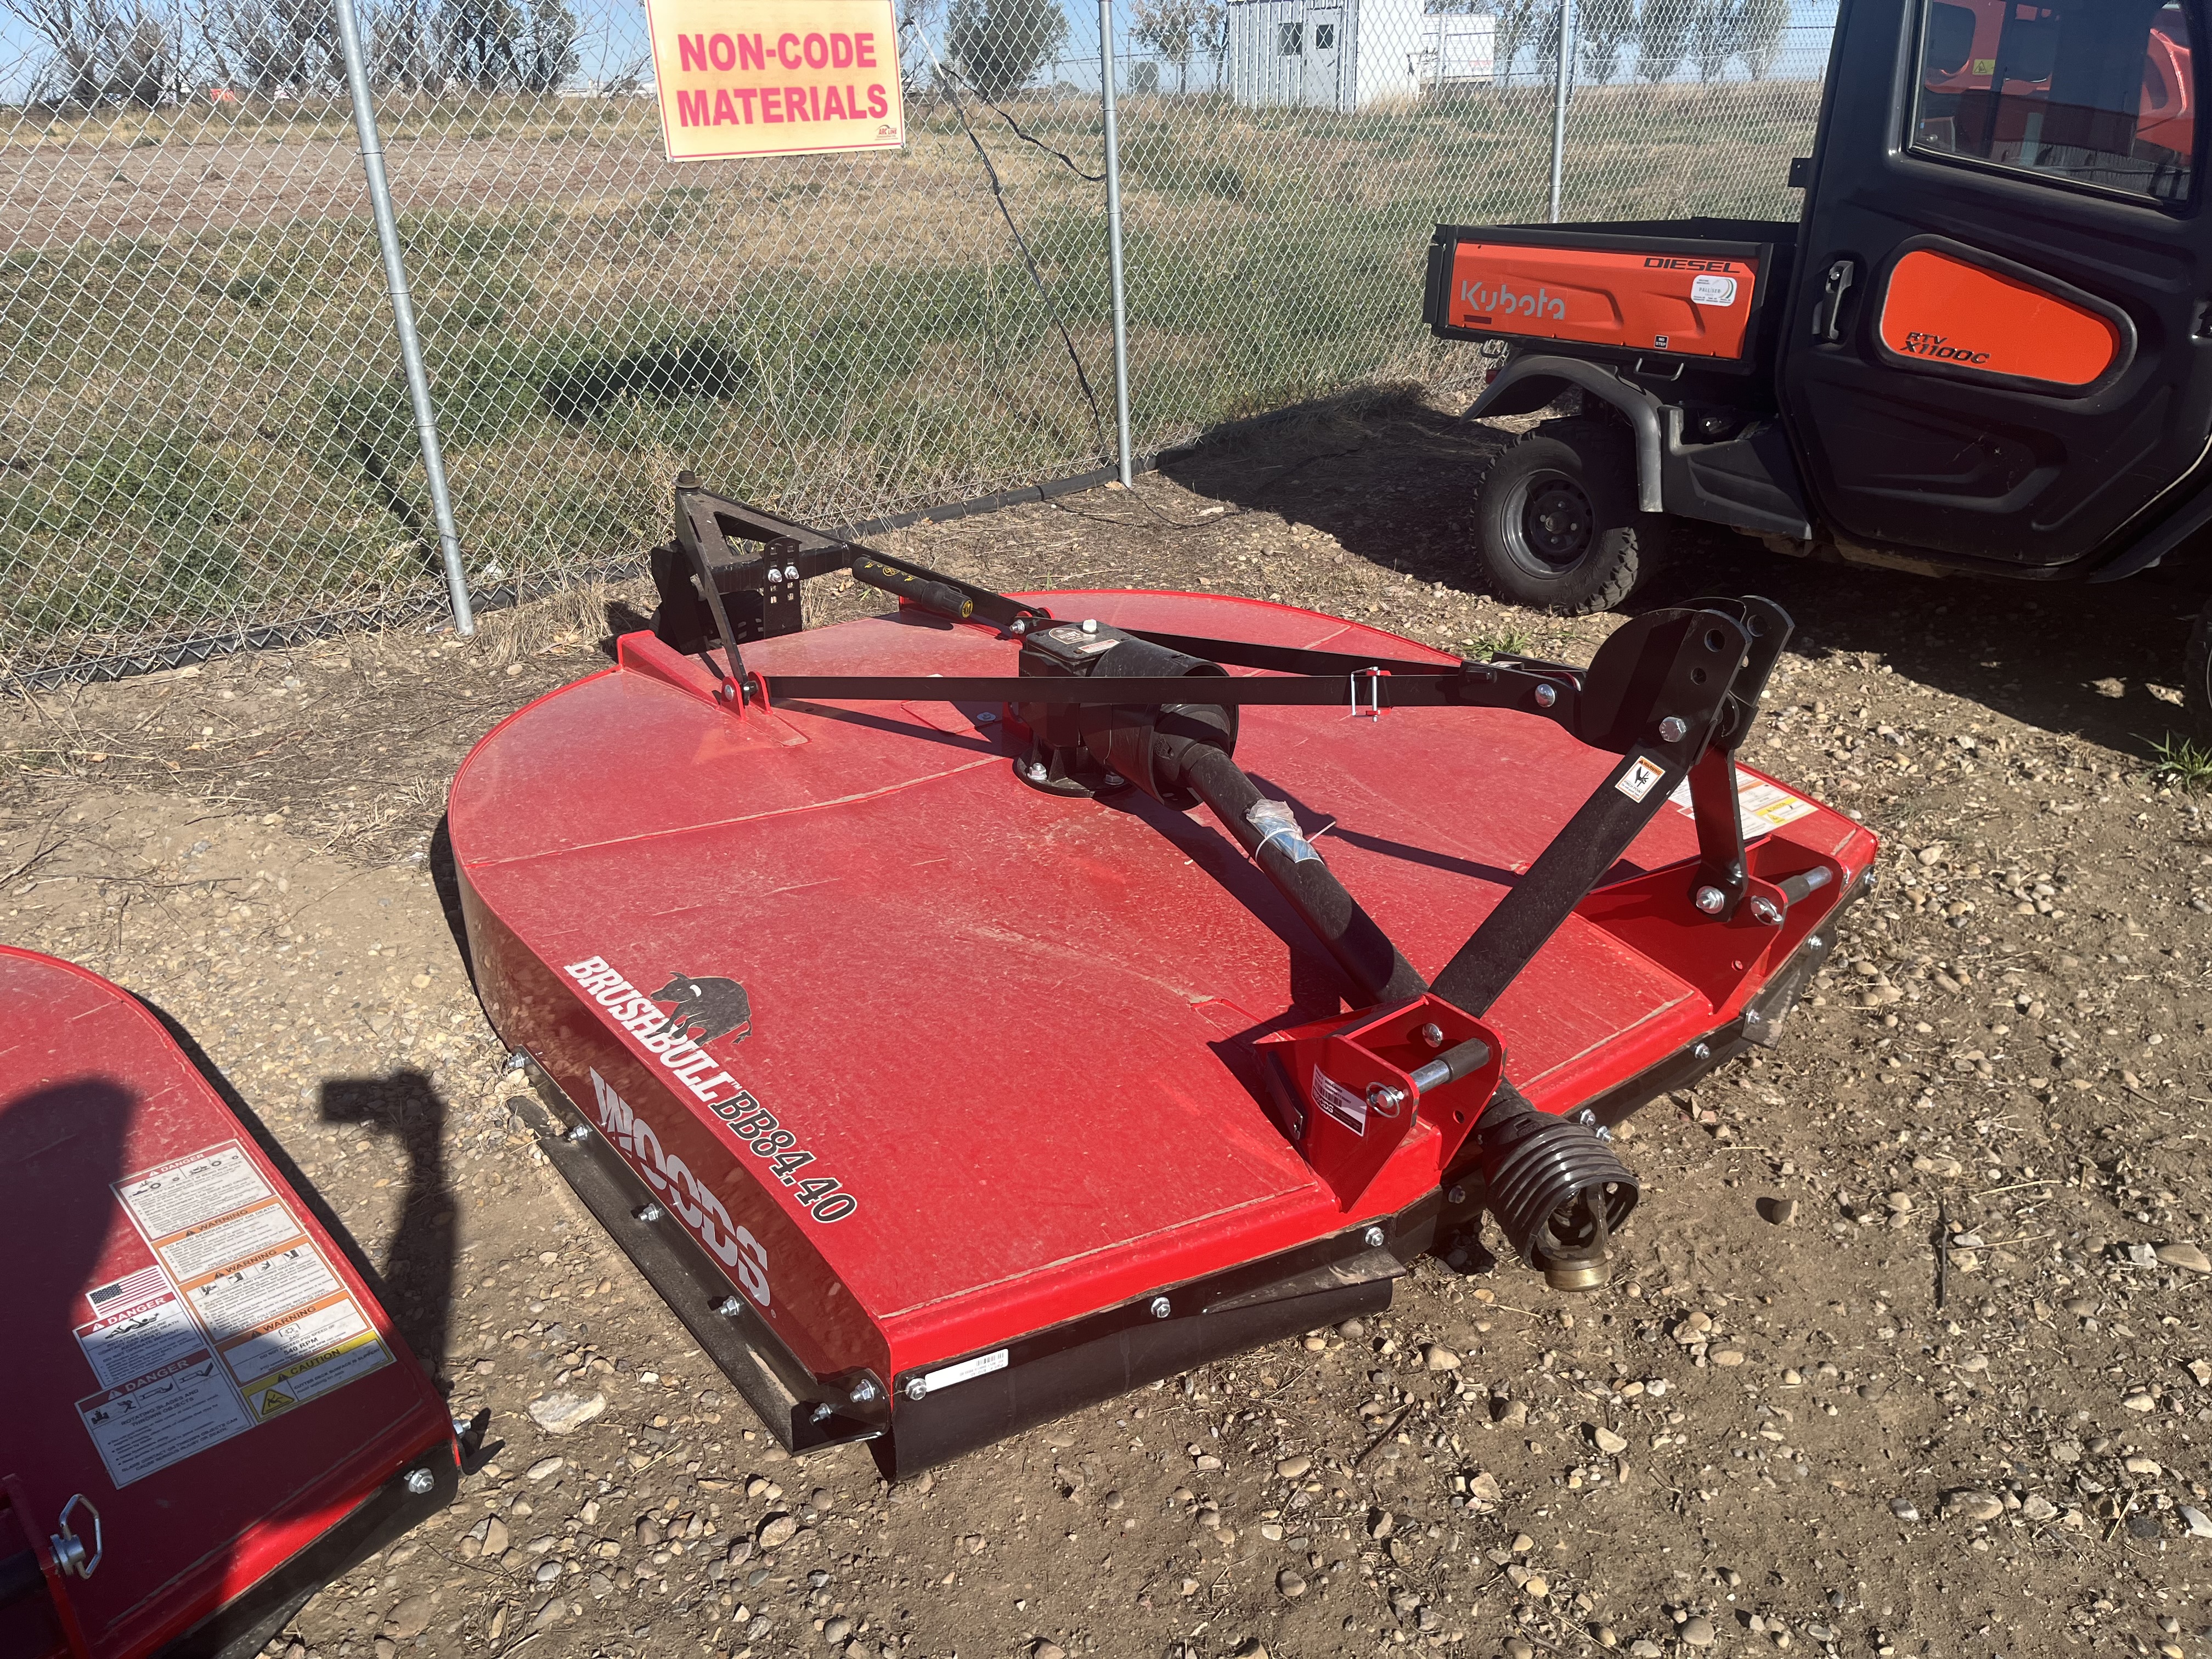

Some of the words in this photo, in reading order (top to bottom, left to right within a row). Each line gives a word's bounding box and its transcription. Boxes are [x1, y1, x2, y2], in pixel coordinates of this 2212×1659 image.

[678, 33, 877, 71] NON-CODE
[676, 84, 888, 127] MATERIALS
[1644, 257, 1741, 274] DIESEL
[1460, 280, 1565, 320] Kubota
[1906, 332, 1948, 343] RTV
[1900, 341, 1990, 364] X1100C
[160, 1153, 205, 1172] DANGER
[710, 1090, 857, 1223] BB84.40
[589, 1065, 770, 1307] WOODS
[174, 1236, 194, 1246] AVOID
[194, 1226, 222, 1239] SERIOUS
[222, 1217, 245, 1228] INJURY
[196, 1208, 249, 1232] WARNING
[224, 1248, 278, 1274] WARNING
[106, 1297, 167, 1325] DANGER
[262, 1305, 317, 1333] WARNING
[97, 1342, 125, 1356] CONTACT
[126, 1336, 139, 1344] CAN
[139, 1328, 159, 1339] CAUSE
[159, 1319, 179, 1330] DEATH
[106, 1333, 137, 1347] ROTATING
[136, 1321, 167, 1335] DRIVELINE
[125, 1339, 153, 1353] OPERATE
[283, 1345, 298, 1356] 540
[298, 1336, 319, 1348] RPM
[124, 1359, 190, 1392] DANGER
[289, 1348, 341, 1375] CAUTION
[120, 1407, 155, 1426] ROTATING
[155, 1395, 184, 1410] BLADES
[183, 1388, 200, 1398] AND
[131, 1410, 162, 1427] THROWN
[162, 1396, 194, 1413] OBJECTS
